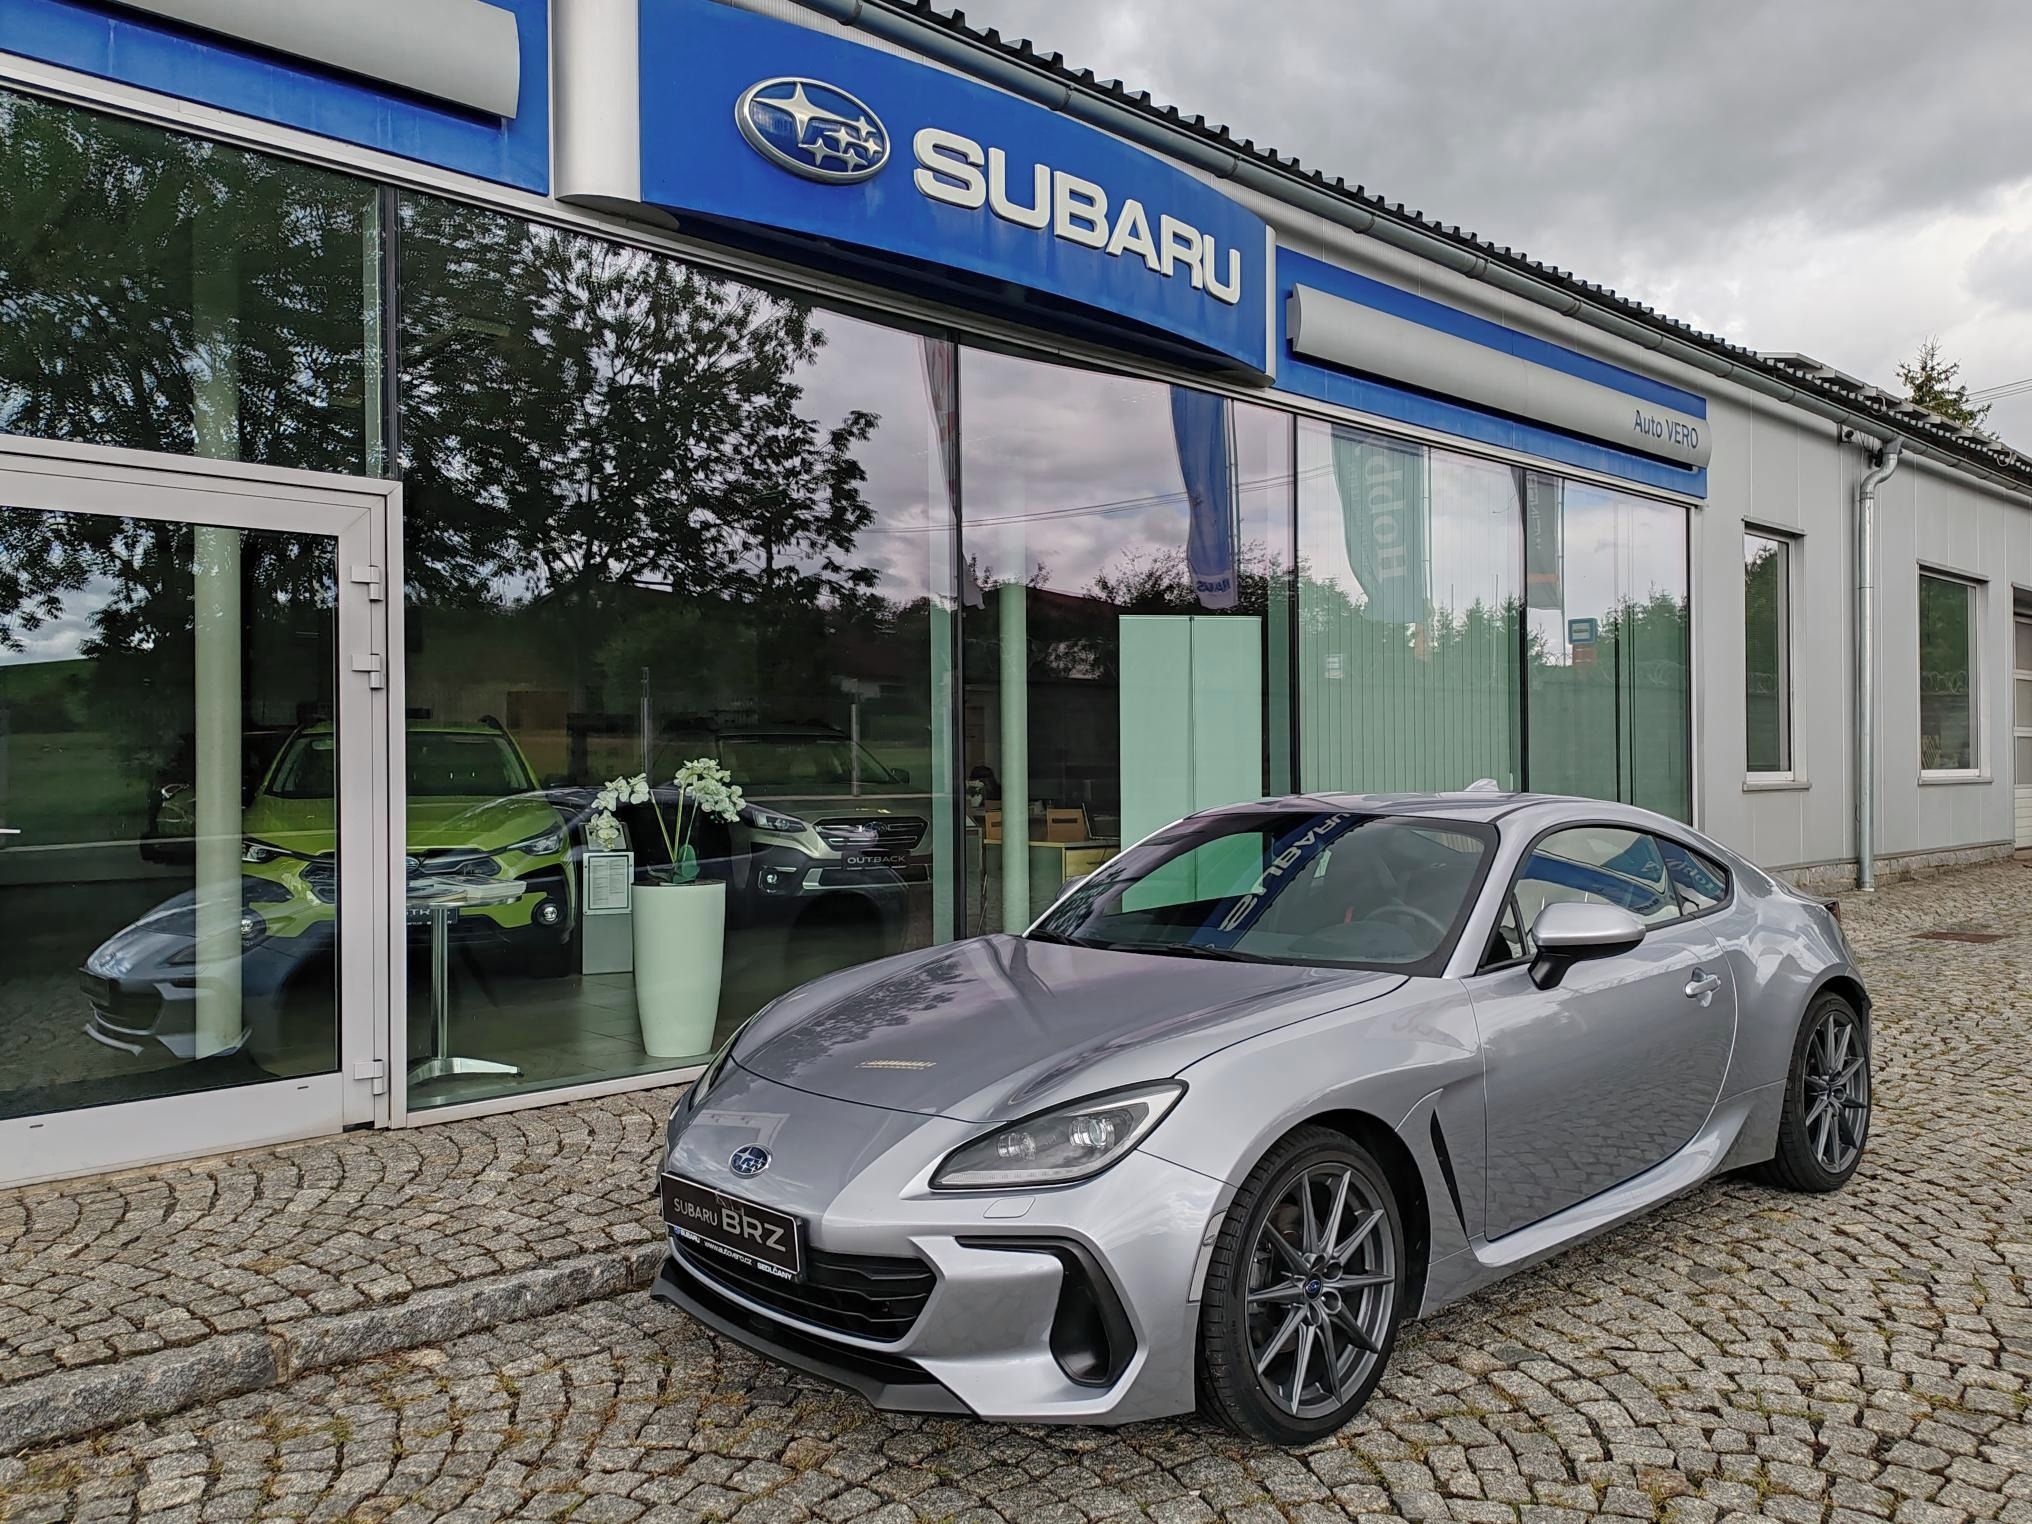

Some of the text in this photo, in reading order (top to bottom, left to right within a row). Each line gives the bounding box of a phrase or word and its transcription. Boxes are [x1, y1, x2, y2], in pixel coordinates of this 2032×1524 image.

[913, 127, 1241, 305] SUBARU
[1633, 409, 1699, 449] Auto VERO
[847, 855, 906, 864] OUTBACK
[673, 1198, 787, 1252] SUBARU BRZ
